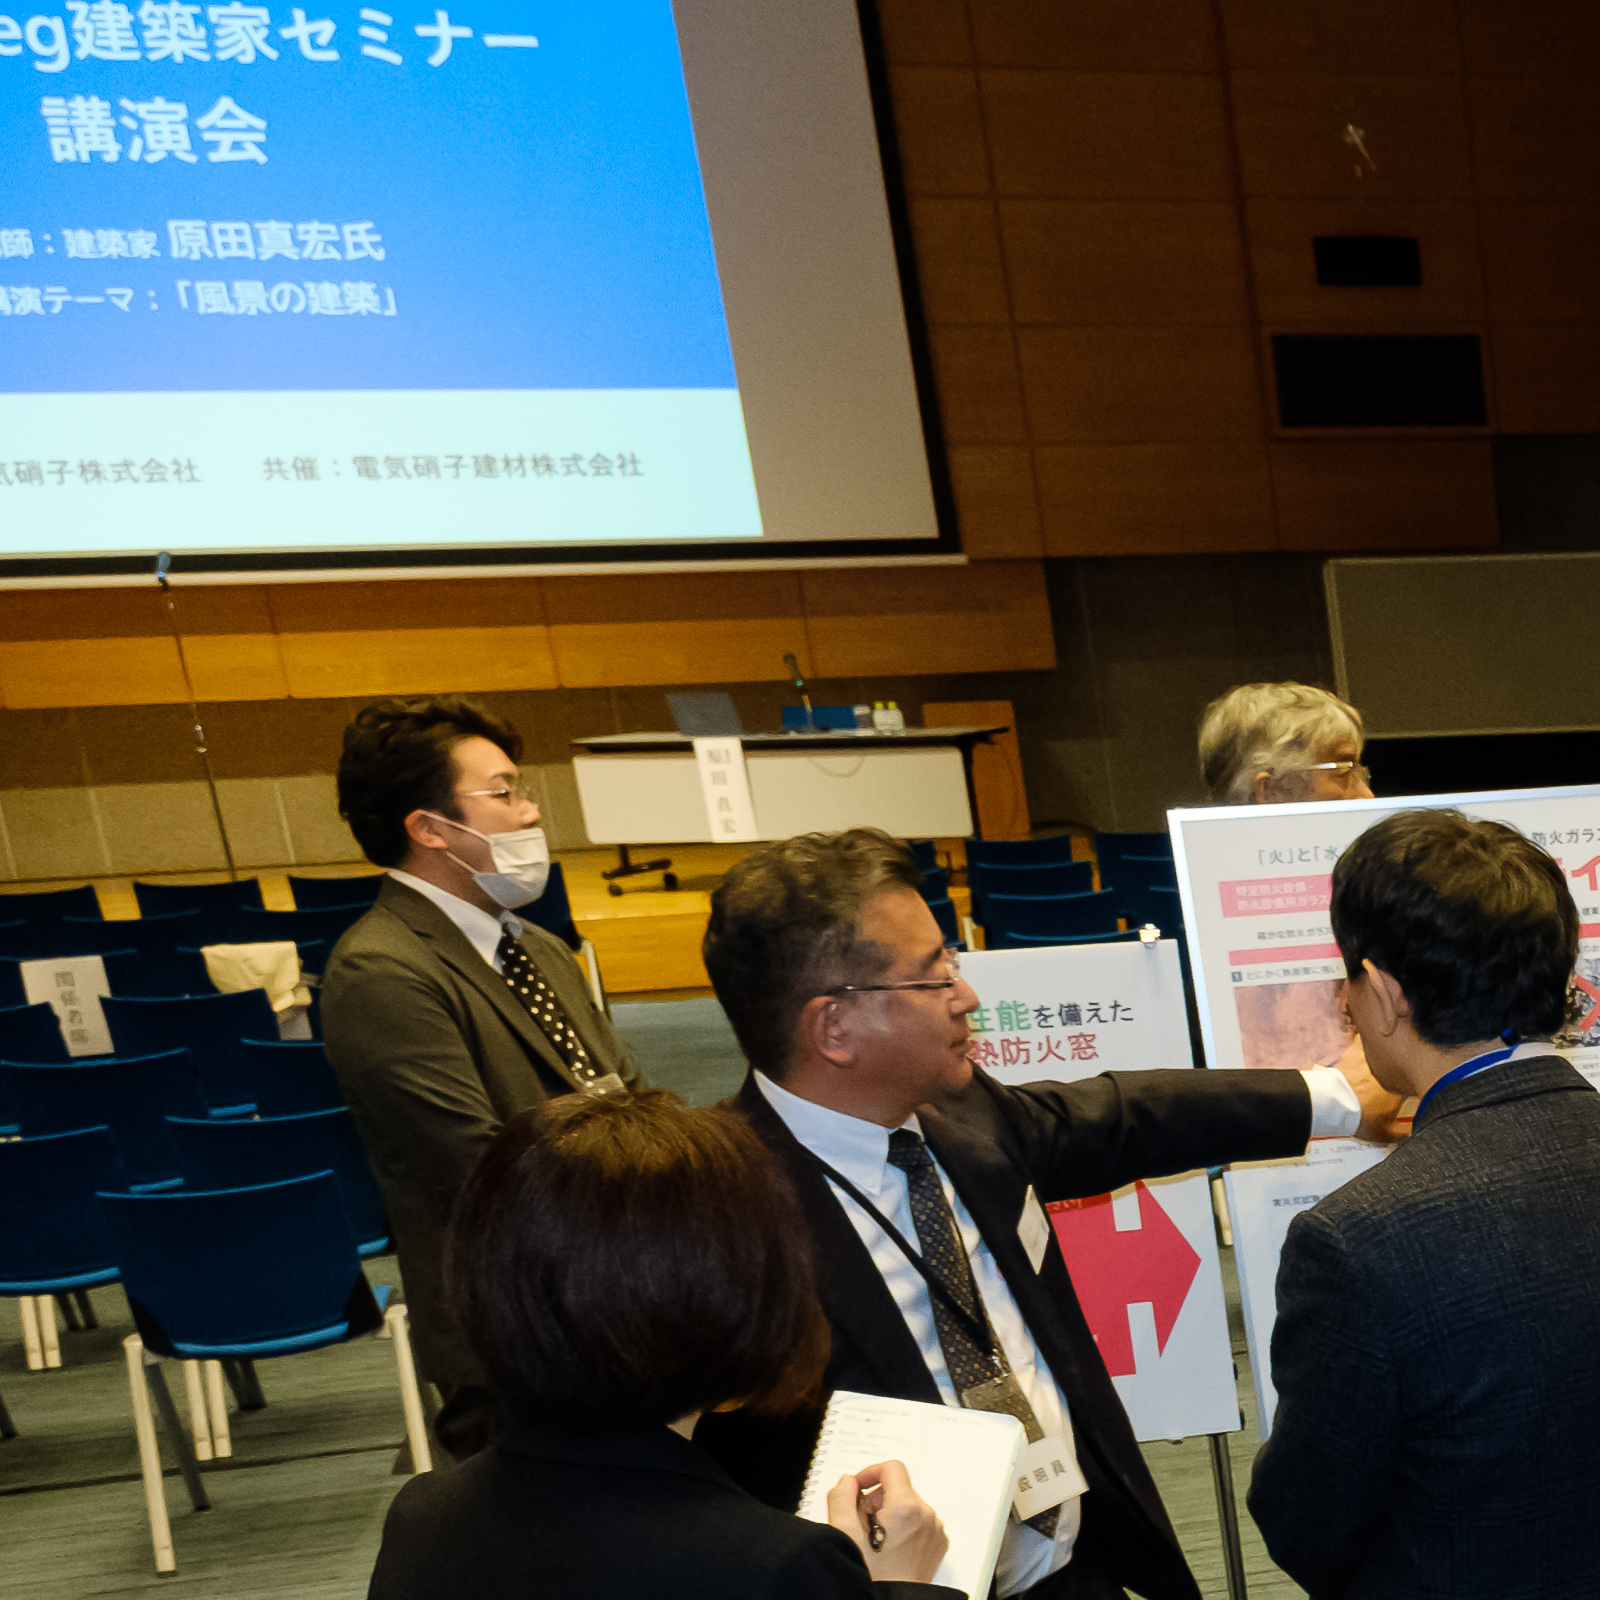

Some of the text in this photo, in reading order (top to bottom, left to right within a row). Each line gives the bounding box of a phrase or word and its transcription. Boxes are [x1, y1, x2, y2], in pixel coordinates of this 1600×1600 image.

[40, 95, 269, 166] 講演会
[167, 219, 387, 262] 原田真宏氏
